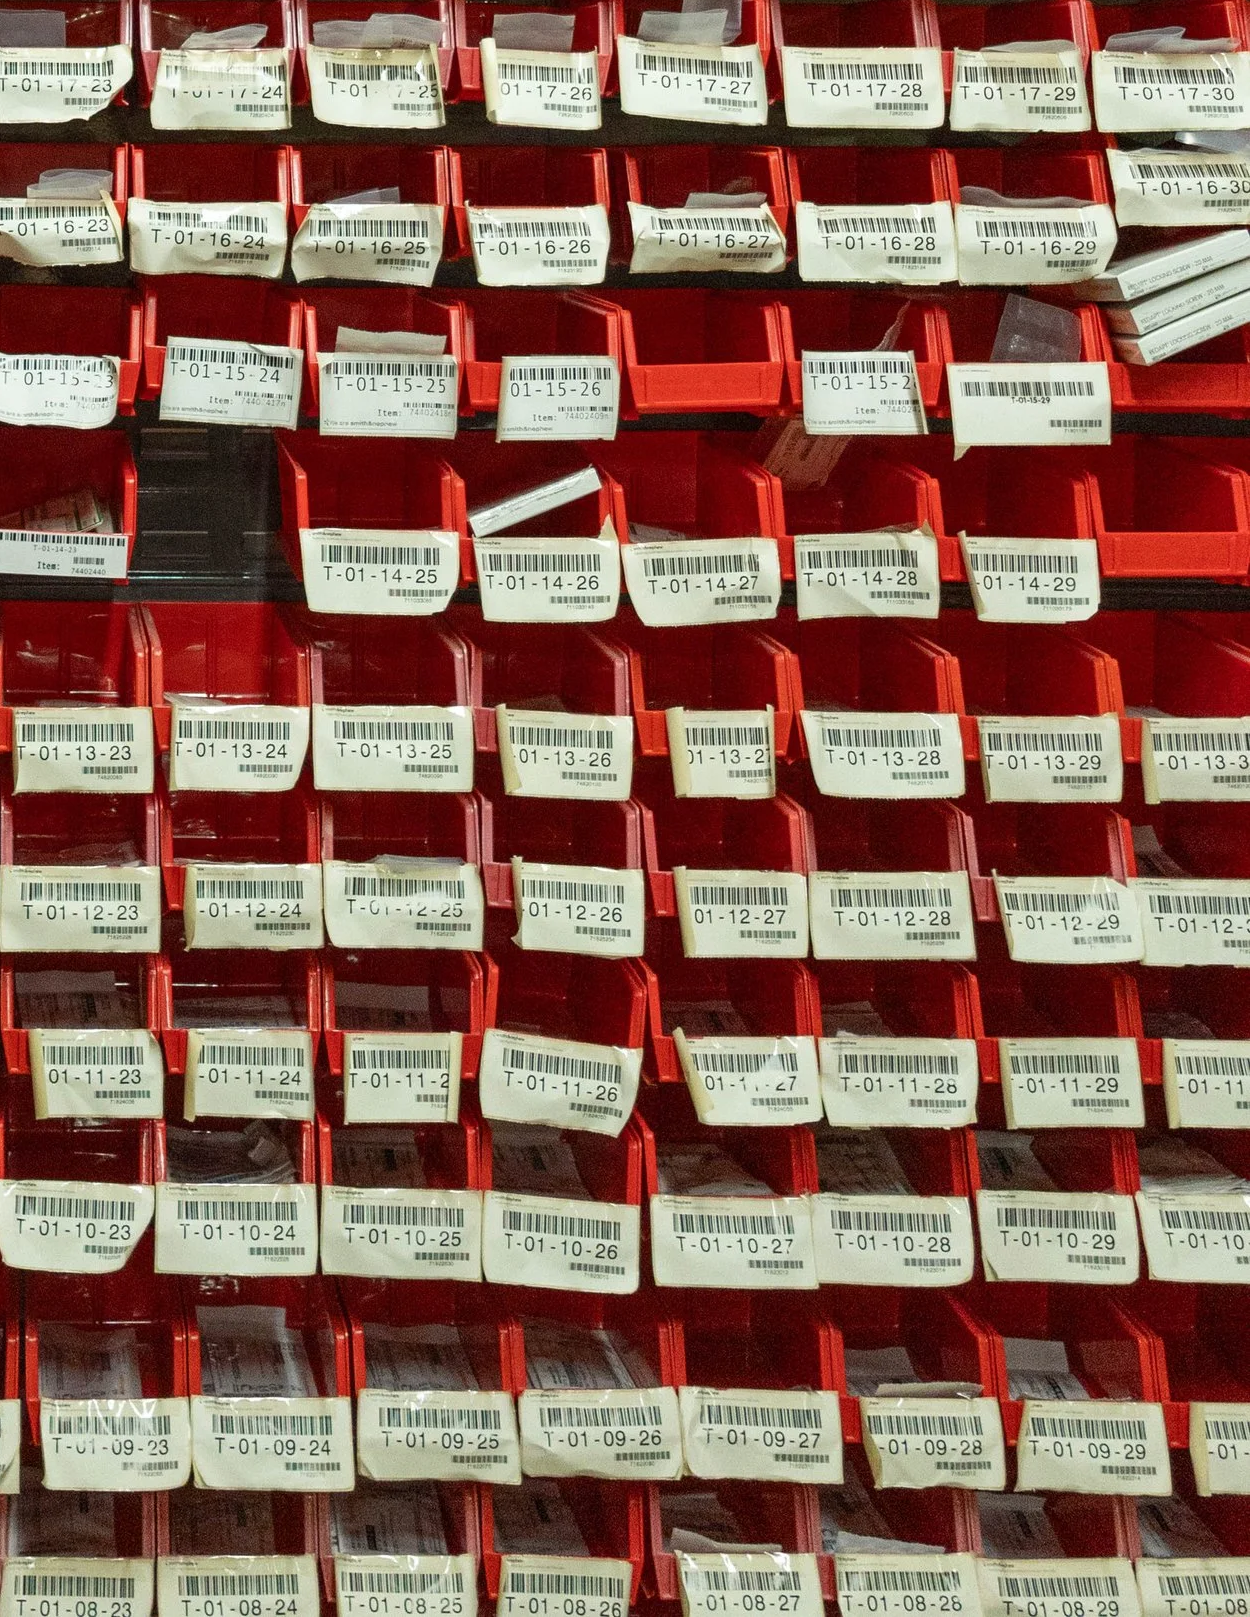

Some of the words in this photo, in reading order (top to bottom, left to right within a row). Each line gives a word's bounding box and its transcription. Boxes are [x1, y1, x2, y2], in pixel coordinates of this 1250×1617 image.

[637, 72, 751, 95] T-01-17-27
[807, 82, 922, 98] T-01-17-28
[960, 85, 1076, 102] T-01-17-29
[1118, 86, 1235, 101] T-01-17-30
[150, 228, 266, 250] T-01-16-24
[475, 239, 591, 255] T-01-16-26
[656, 234, 770, 249] T-01-16-27
[822, 236, 935, 251] T-01-16-28
[980, 240, 1096, 256] T-01-16-29
[170, 362, 280, 382] T-01-15-24
[333, 376, 447, 393] T-01-15-25
[1011, 396, 1051, 404] T-01-15-29
[323, 565, 438, 583] T-01-14-25
[486, 575, 600, 590] T-01-14-26
[803, 571, 918, 587] T-01-14-28
[648, 576, 758, 594] T-01-14-27
[17, 745, 132, 760] T-01-13-23
[175, 743, 288, 759] T-01-13-24
[337, 743, 452, 759] T-01-13-25
[825, 749, 941, 766] T-01-13-28
[985, 754, 1101, 770] T-01-13-29
[23, 905, 139, 921] T-01-12-23
[834, 910, 951, 926] T-01-12-28
[504, 1072, 618, 1102] T-01-11-26
[840, 1077, 958, 1094] T-01-11-28
[16, 1219, 131, 1240] T-01-10-23
[180, 1223, 296, 1241] T-01-10-24
[345, 1228, 462, 1246] T-01-10-25
[505, 1234, 618, 1260] T-01-10-26
[676, 1237, 793, 1253] T-01-10-27
[835, 1234, 951, 1252] T-01-10-28
[1000, 1231, 1116, 1250] T-01-10-29
[215, 1437, 331, 1456] T-01-09-24
[382, 1432, 499, 1449] T-01-09-25
[544, 1429, 663, 1447] T-01-09-26
[703, 1429, 820, 1448] T-01-09-27
[1028, 1440, 1145, 1459] T-01-09-29
[182, 1598, 298, 1616] T-01-08-24
